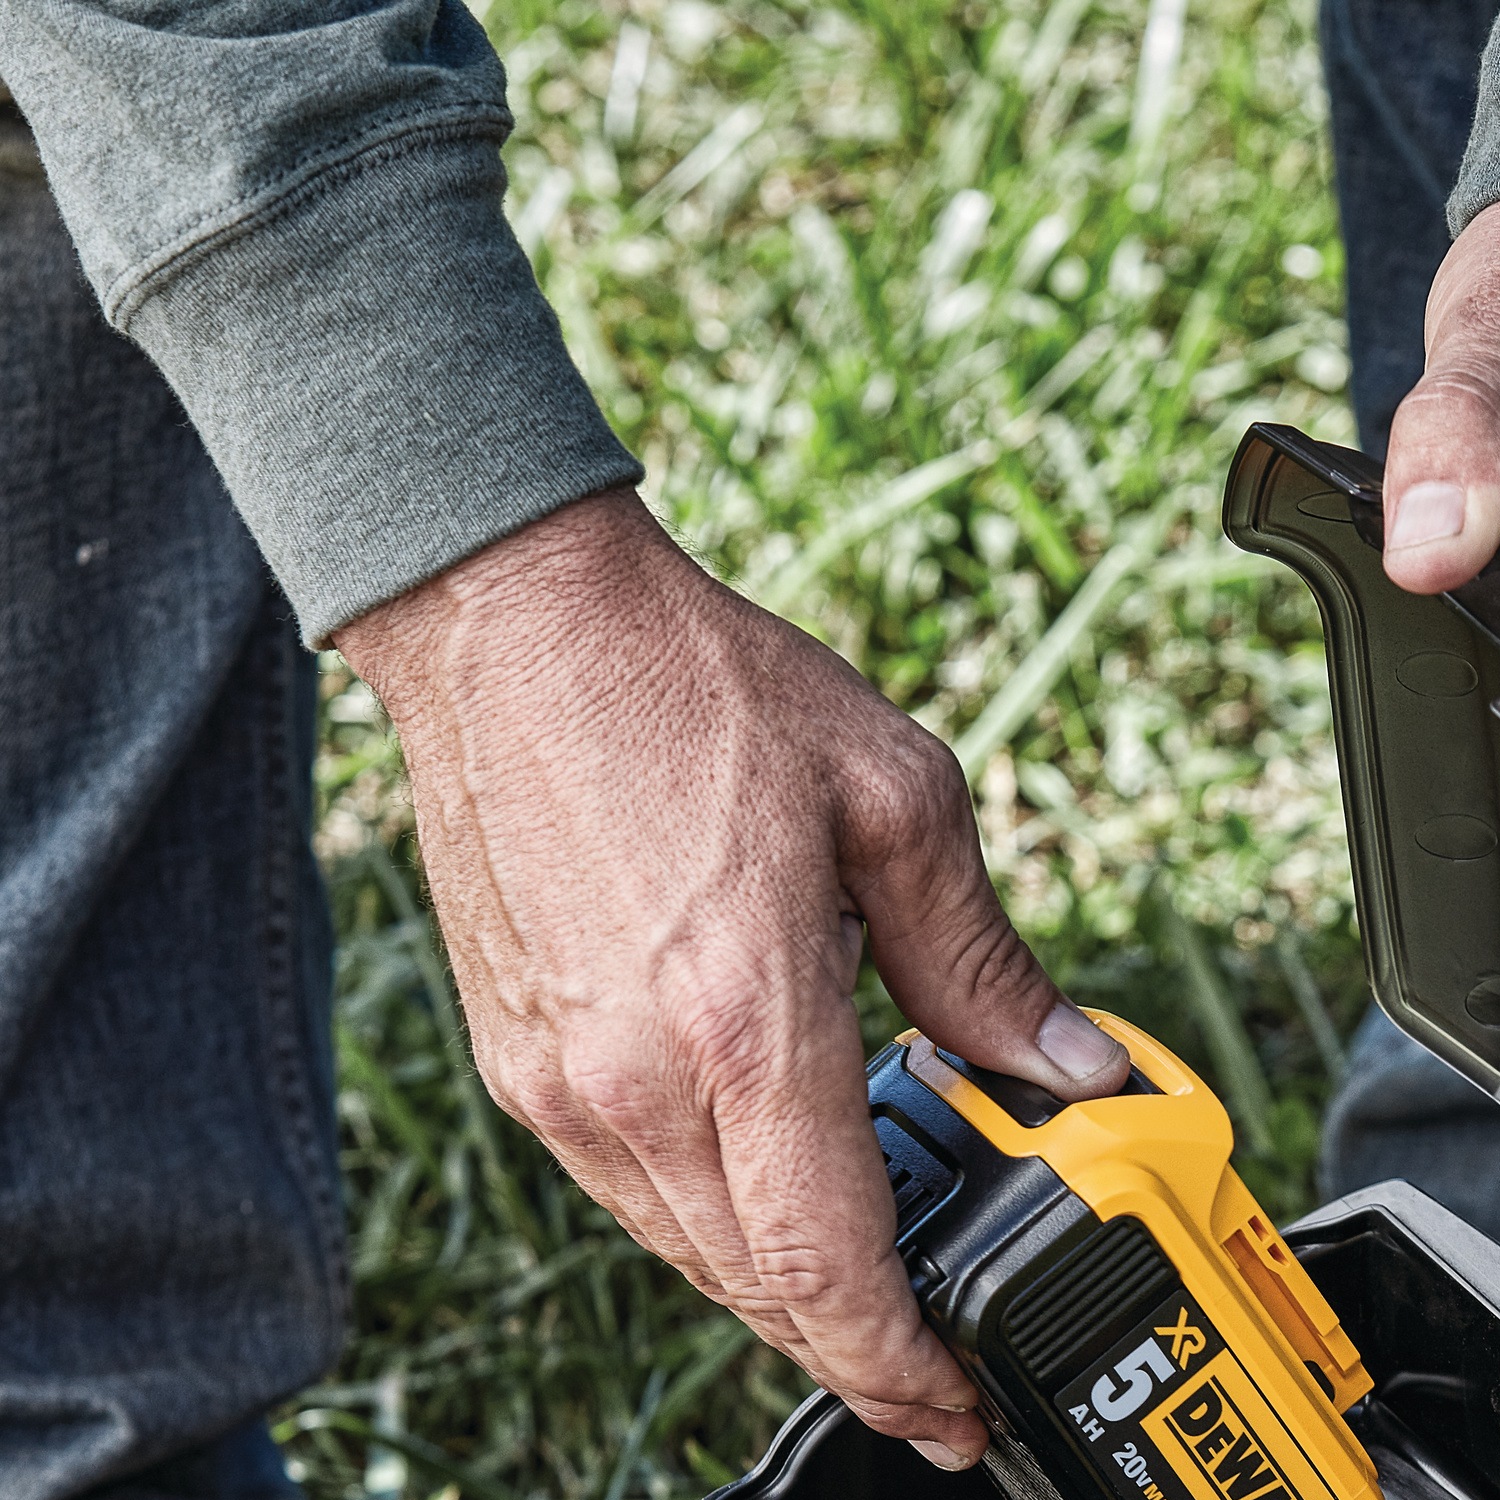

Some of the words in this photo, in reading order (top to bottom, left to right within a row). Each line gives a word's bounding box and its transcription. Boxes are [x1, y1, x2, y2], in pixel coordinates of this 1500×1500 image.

[1153, 1306, 1207, 1371] XR
[1091, 1337, 1177, 1422] 5
[1068, 1403, 1106, 1442] AH
